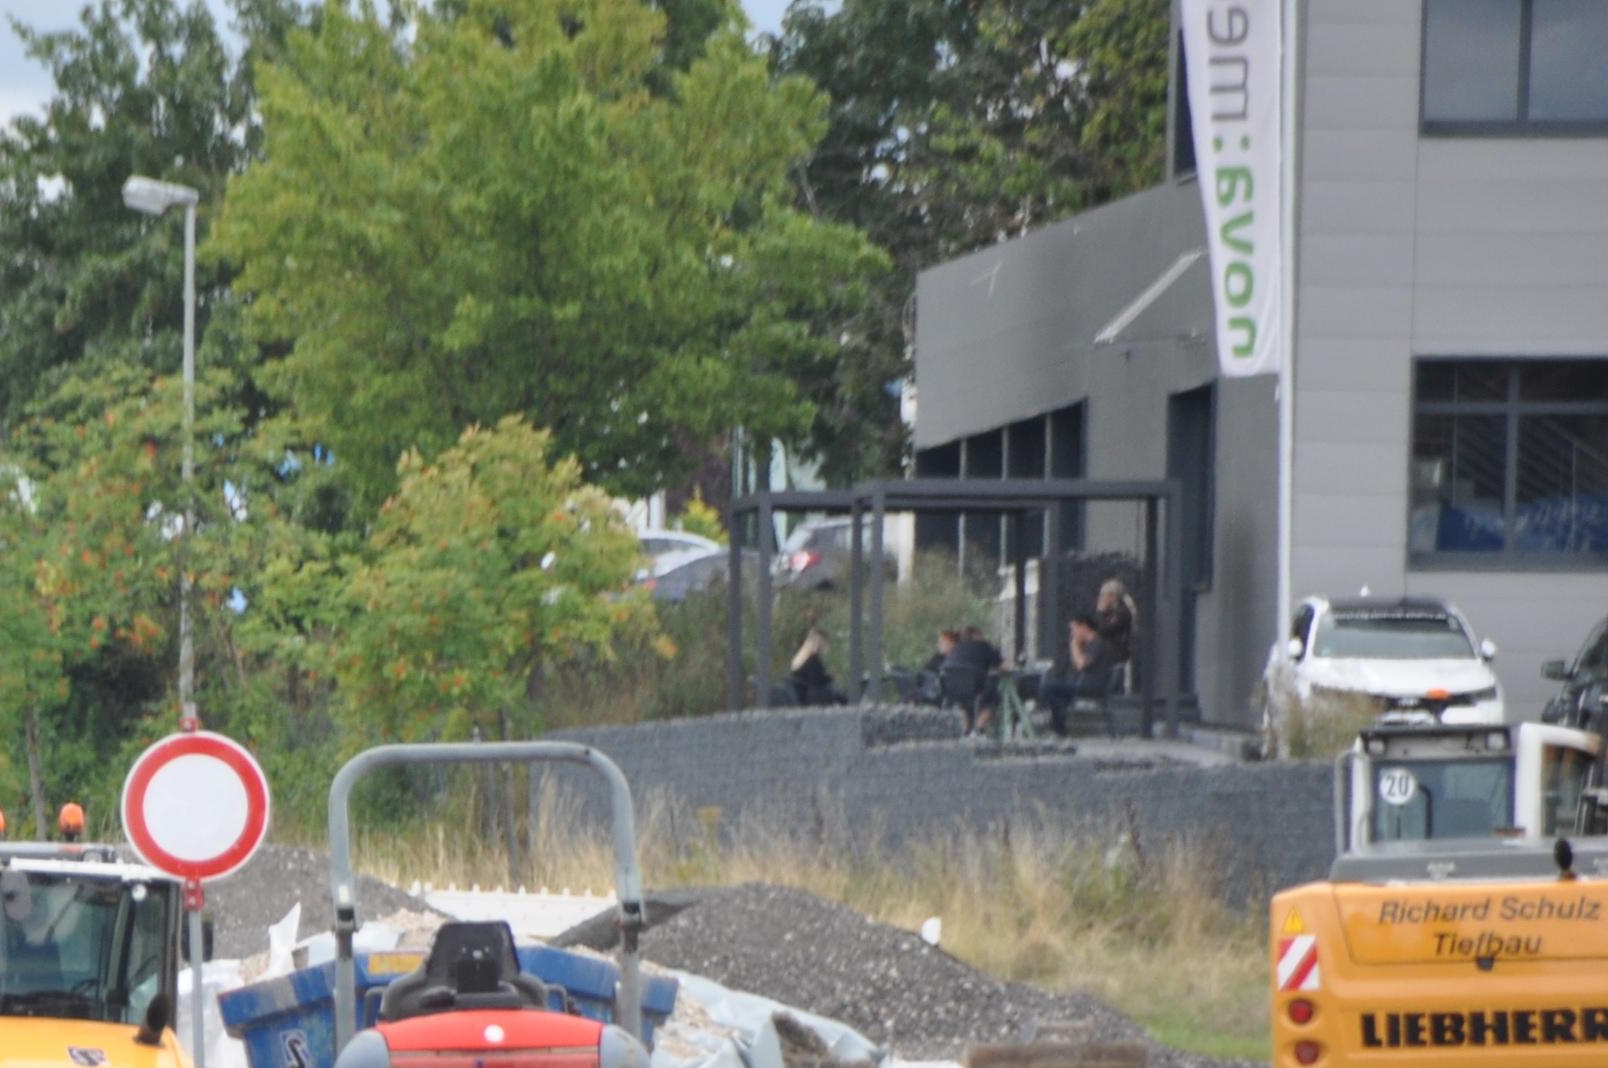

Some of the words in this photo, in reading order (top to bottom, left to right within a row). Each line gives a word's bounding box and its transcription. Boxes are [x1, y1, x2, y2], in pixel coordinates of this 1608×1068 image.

[1386, 775, 1410, 797] 20
[1378, 897, 1491, 925] Richard
[1499, 896, 1601, 921] Schulz
[1433, 932, 1542, 957] Tiefbau
[1361, 1008, 1608, 1048] LIEBHERR
